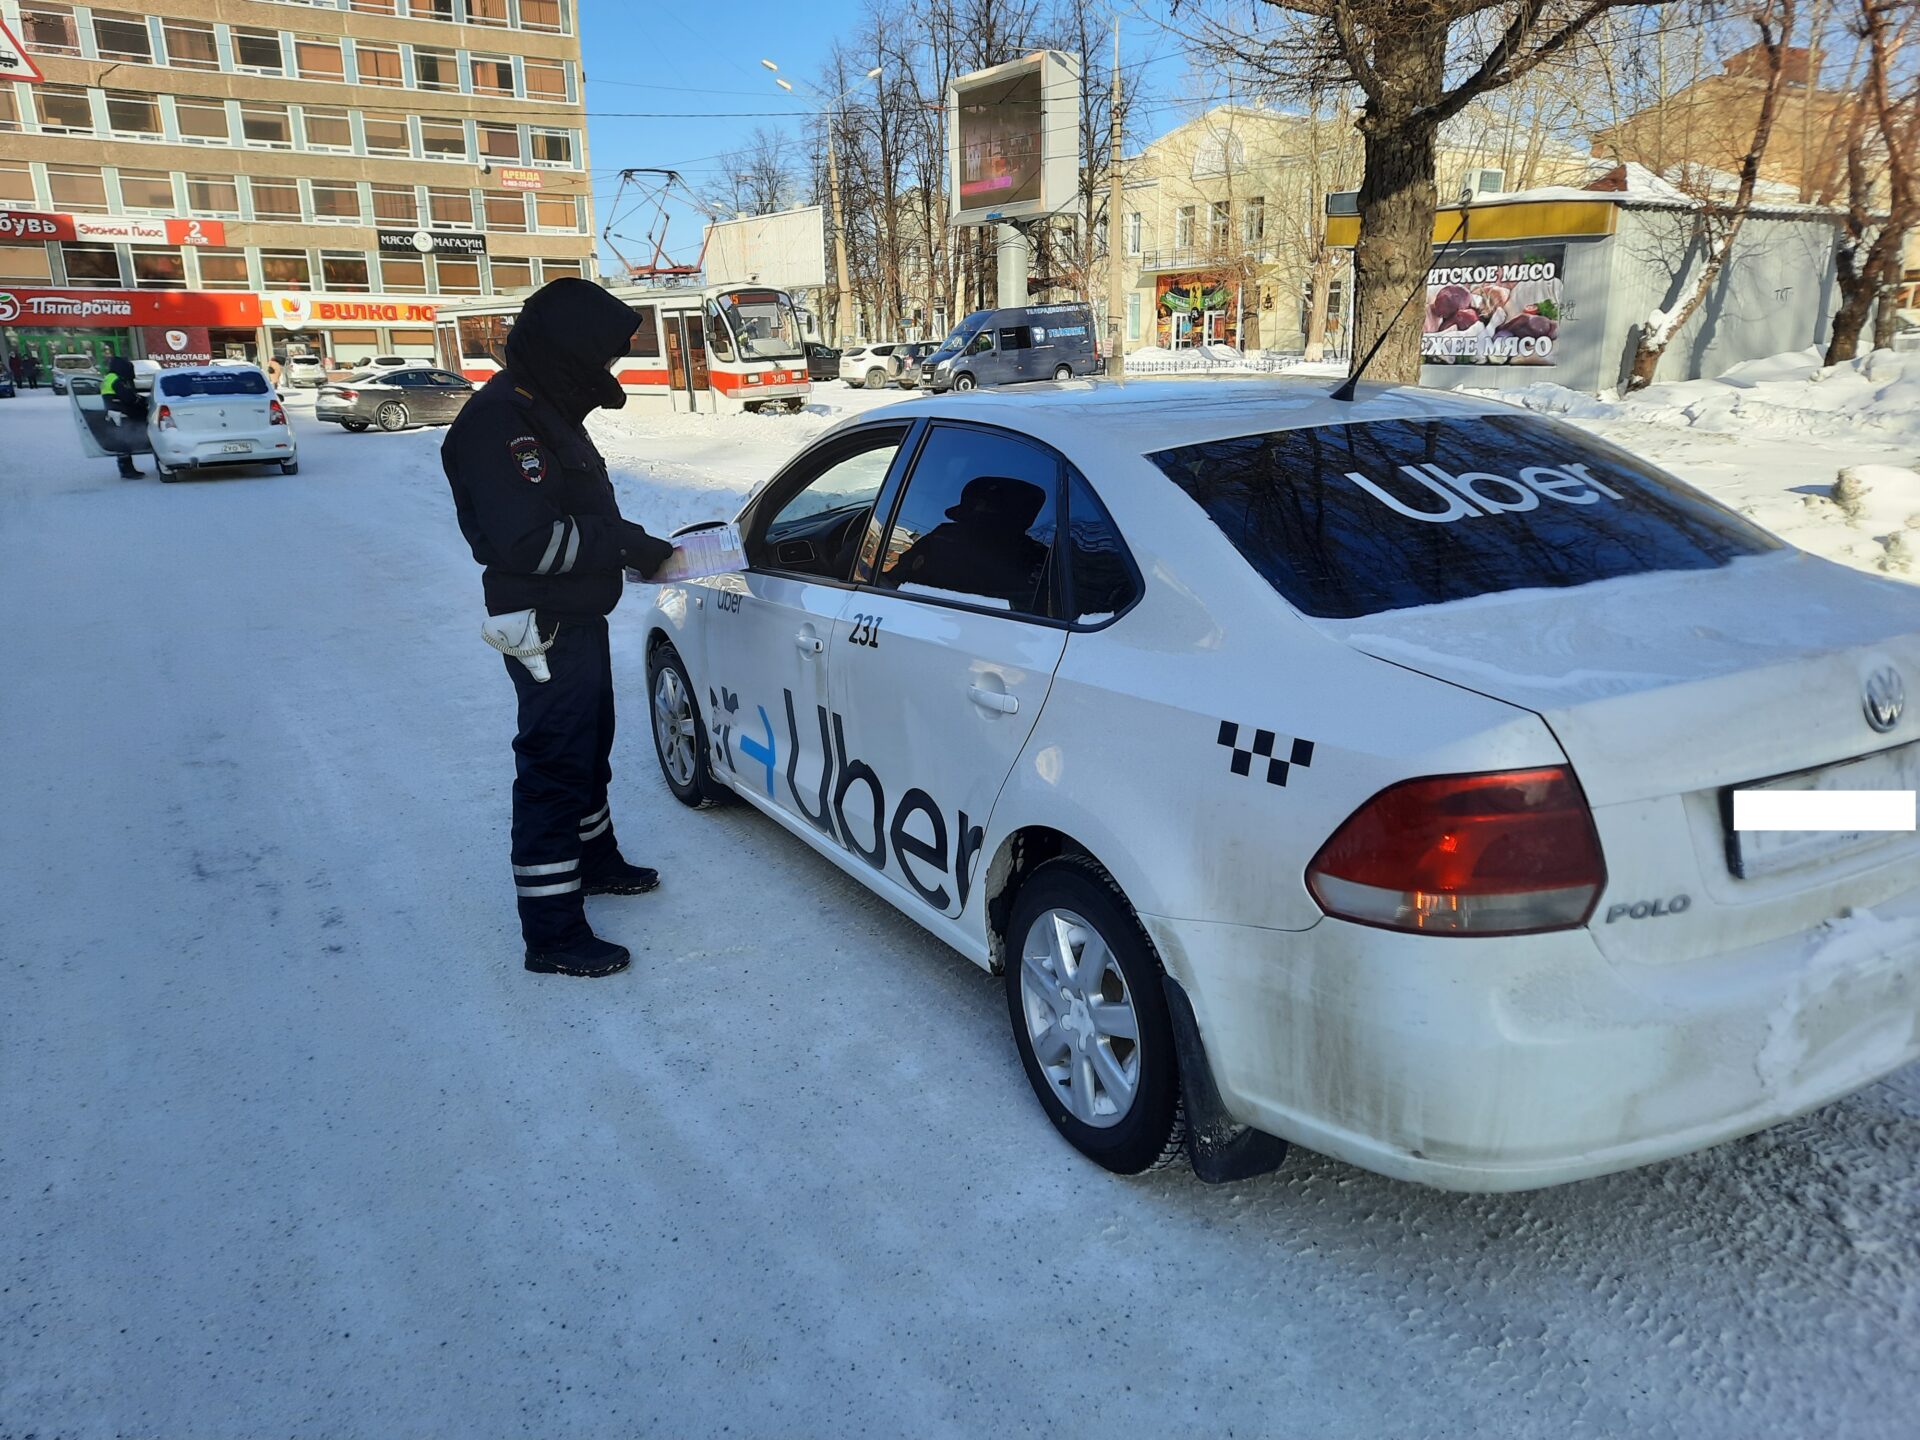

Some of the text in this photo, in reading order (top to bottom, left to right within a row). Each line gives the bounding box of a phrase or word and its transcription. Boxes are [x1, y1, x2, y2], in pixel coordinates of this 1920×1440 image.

[503, 170, 540, 181] АРЕНДА
[188, 221, 201, 237] 2
[381, 235, 412, 245] МЯСО
[433, 238, 482, 248] МАГАЗИН
[1502, 263, 1556, 281] МЯСО
[1483, 336, 1553, 357] МЯСО
[165, 353, 210, 361] РАБОТАЕМ
[771, 374, 786, 384] 349
[1343, 462, 1624, 523] Uber
[849, 613, 883, 648] 231
[783, 688, 984, 910] Uber
[1606, 894, 1692, 924] POLO
